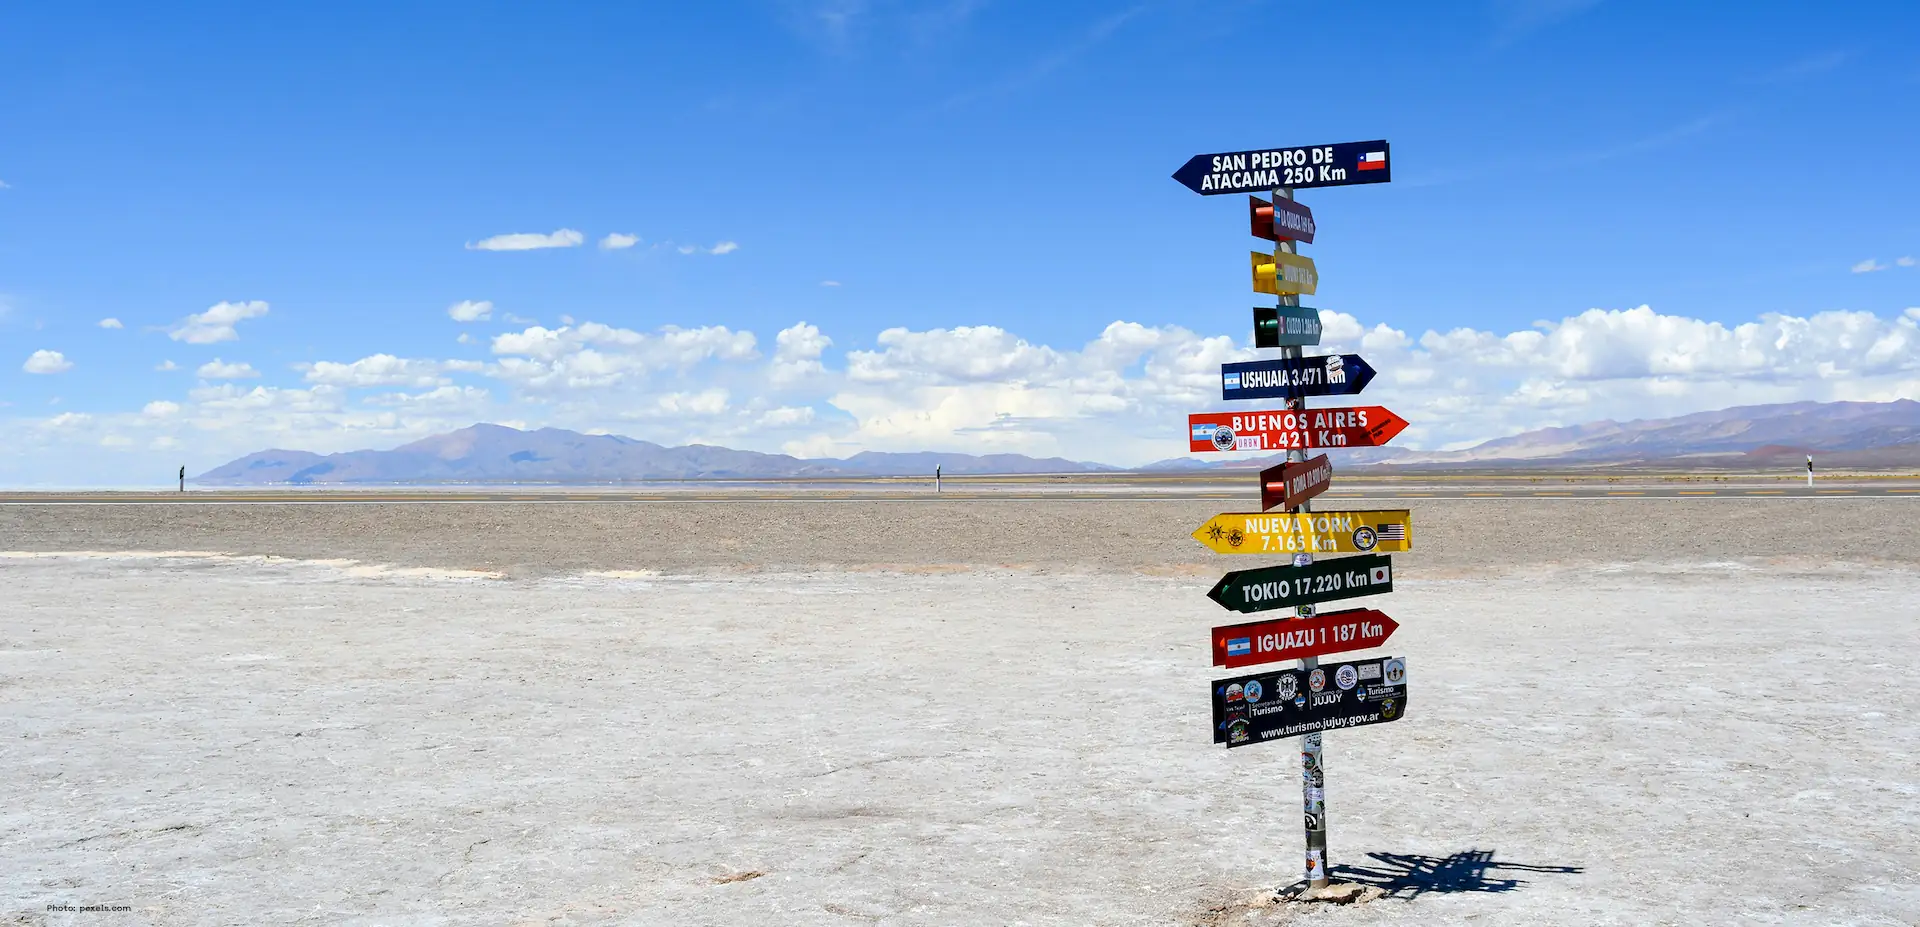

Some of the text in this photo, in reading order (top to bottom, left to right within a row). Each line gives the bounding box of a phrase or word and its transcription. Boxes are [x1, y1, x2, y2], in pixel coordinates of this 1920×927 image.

[1212, 147, 1333, 173] SAN PEDRO DE
[1201, 165, 1346, 191] ATACAMA 250 Km
[1241, 370, 1290, 389] USHUAIA
[1292, 368, 1322, 386] 3.471
[1232, 410, 1368, 432] BUENOS AIRES
[1260, 432, 1311, 449] 1.421
[1318, 430, 1347, 447] Km
[1245, 516, 1352, 534] NUEVA YORK
[1262, 535, 1306, 551] 7.165
[1311, 535, 1338, 551] Km
[1242, 570, 1368, 603] TOKIO 17.220 Km
[1257, 628, 1315, 653] IGUAZU
[1332, 624, 1357, 642] 187
[1361, 621, 1383, 638] Km
[1312, 693, 1343, 707] JUJUY
[1367, 687, 1394, 696] Turismo
[1252, 705, 1283, 717] Turismo
[1261, 713, 1380, 739] www.turismo.jujuy.gov.ar
